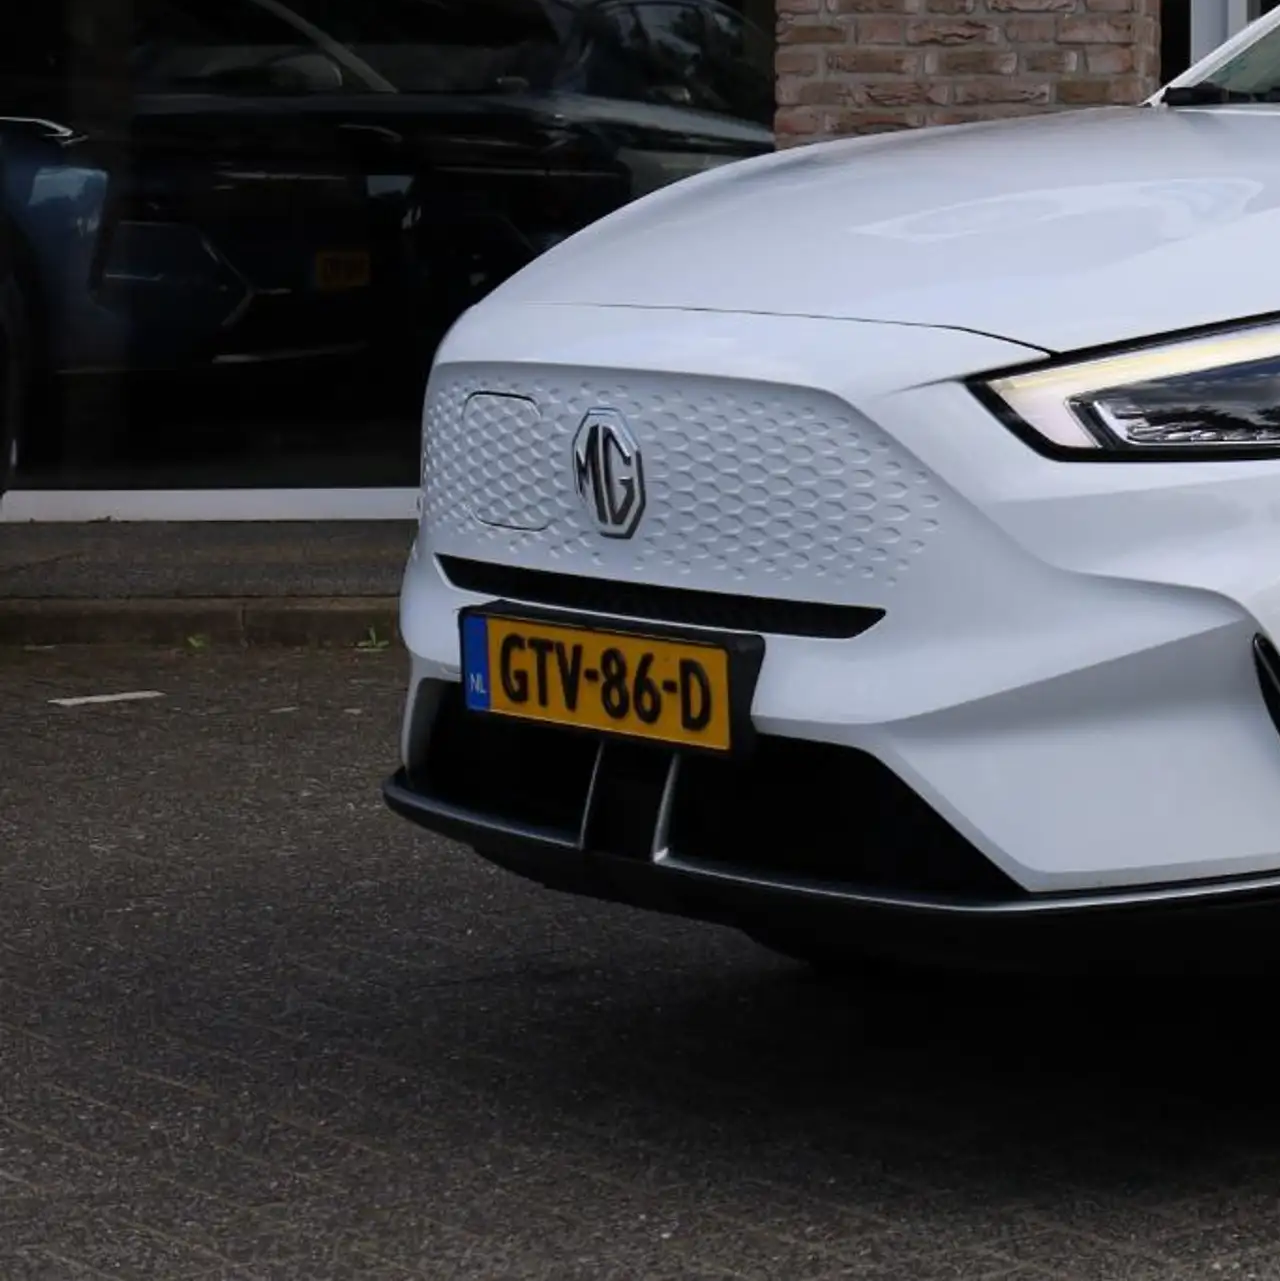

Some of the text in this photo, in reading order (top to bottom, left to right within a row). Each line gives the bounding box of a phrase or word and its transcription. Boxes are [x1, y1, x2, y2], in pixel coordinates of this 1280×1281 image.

[575, 424, 635, 526] MG
[468, 672, 487, 694] NL
[501, 633, 712, 732] GTV-86-D
